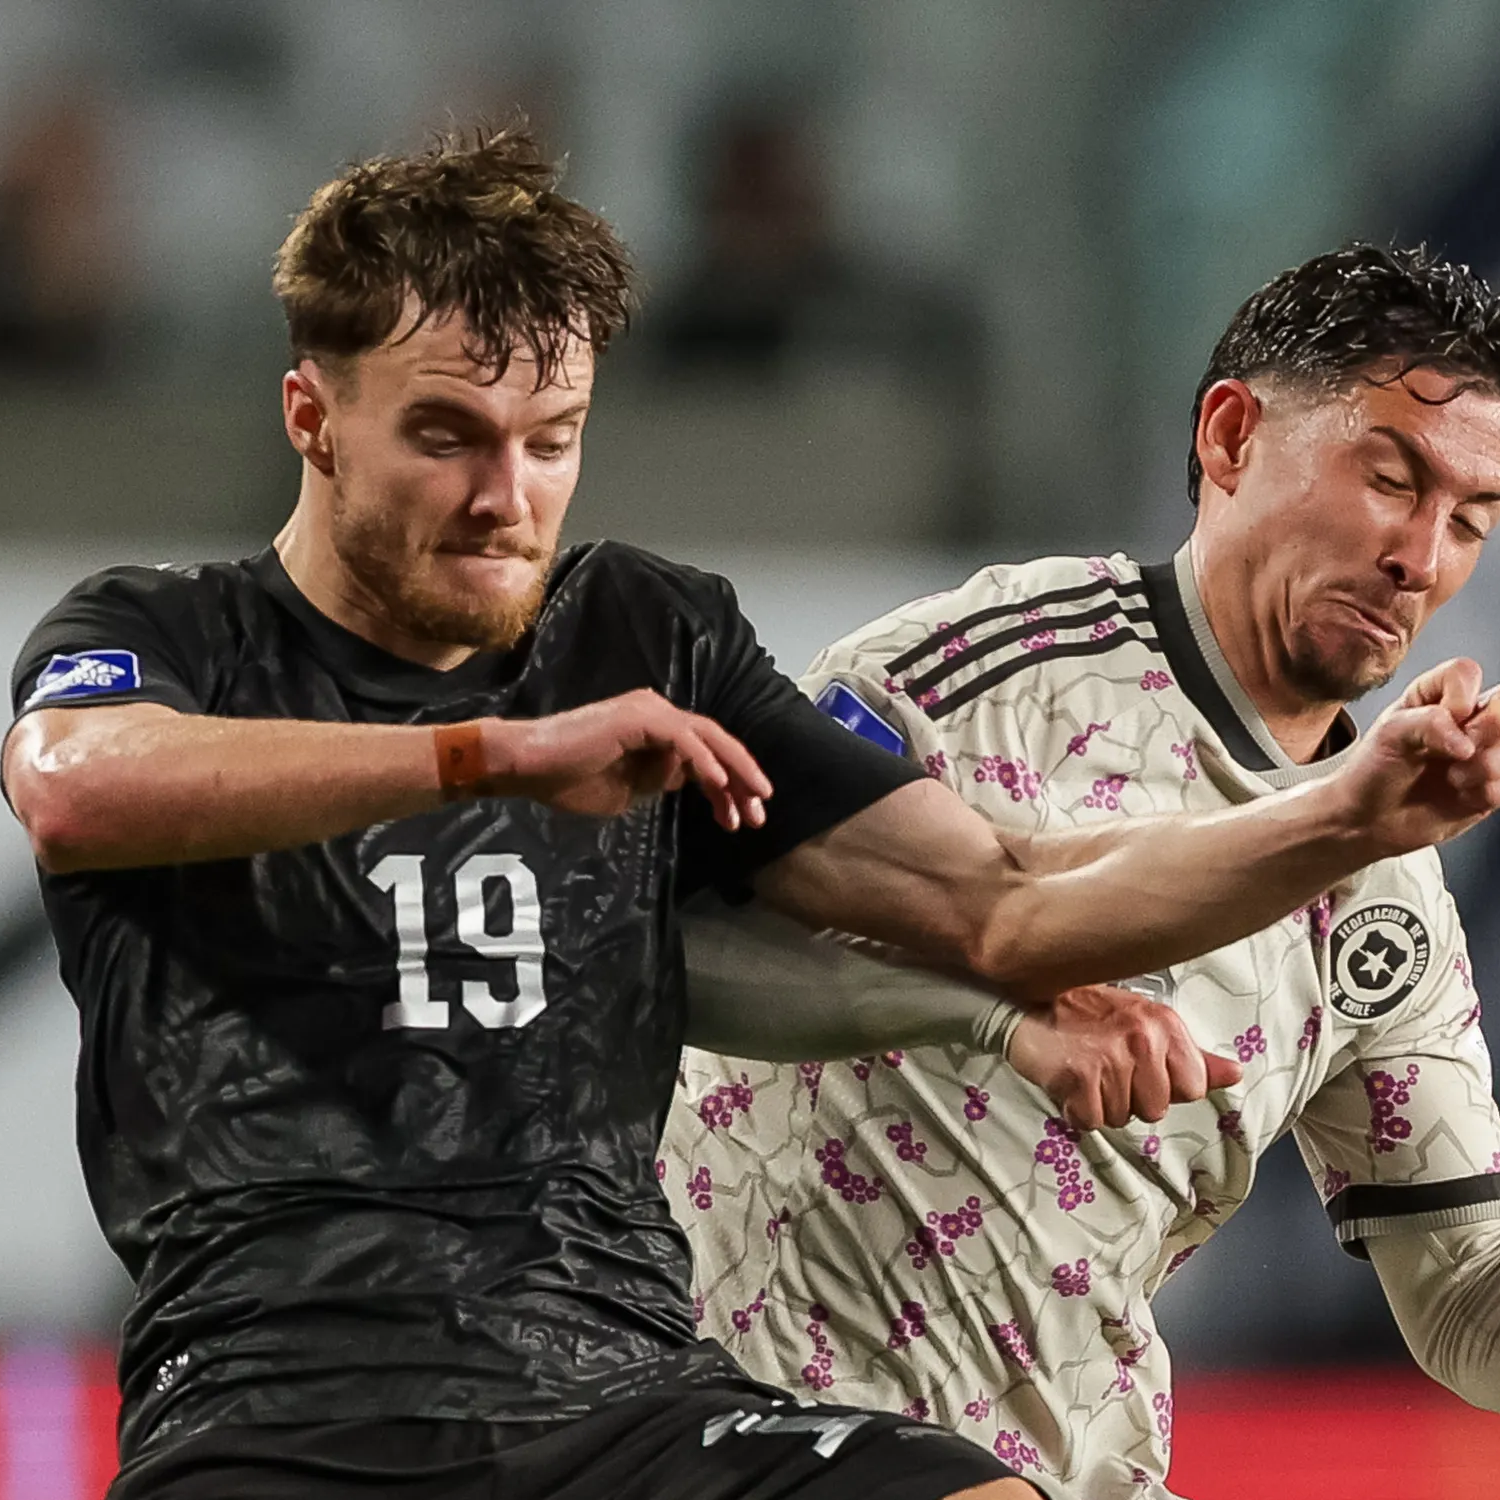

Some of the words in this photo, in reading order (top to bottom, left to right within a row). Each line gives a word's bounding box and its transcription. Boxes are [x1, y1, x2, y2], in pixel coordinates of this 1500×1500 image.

[366, 853, 547, 1030] 19
[1408, 921, 1425, 941] DE
[1404, 941, 1428, 987] FUTBOL
[1340, 997, 1371, 1017] CHILE
